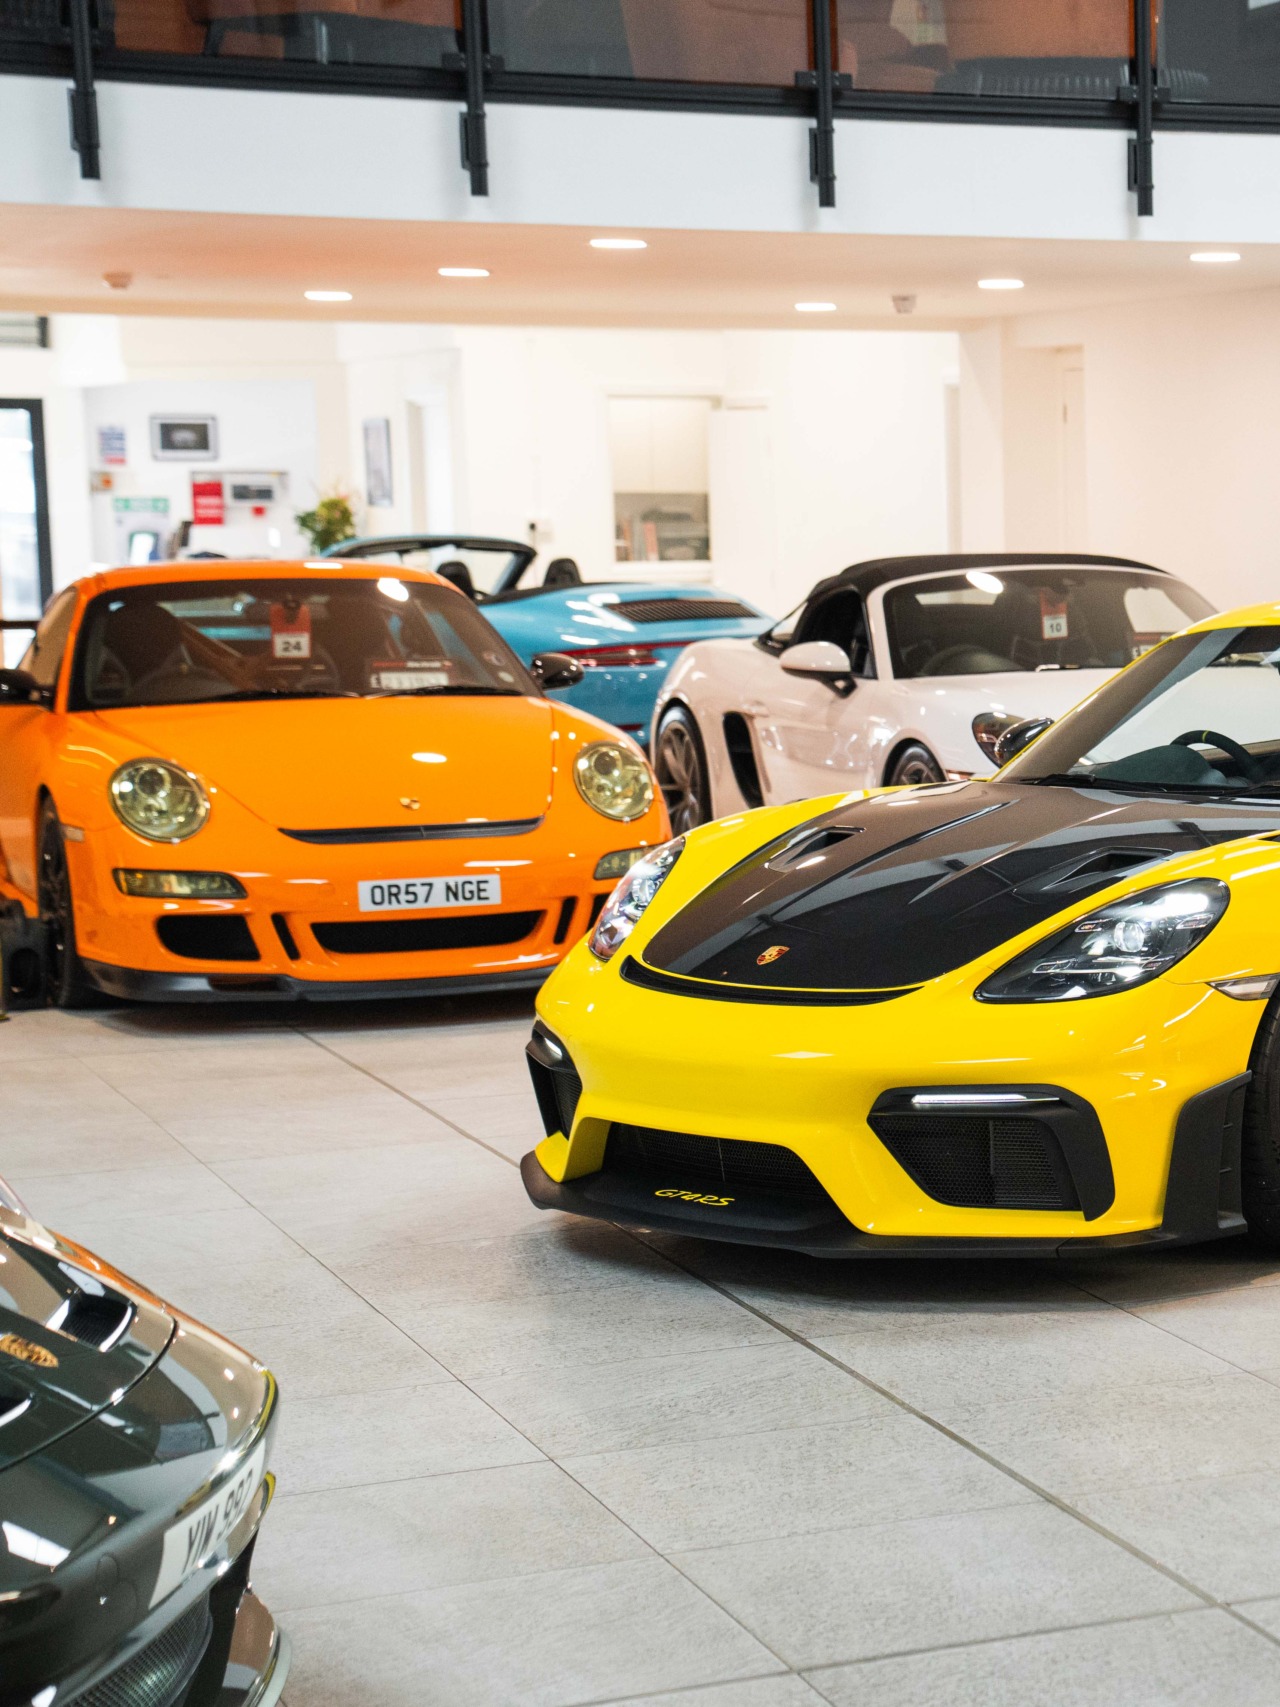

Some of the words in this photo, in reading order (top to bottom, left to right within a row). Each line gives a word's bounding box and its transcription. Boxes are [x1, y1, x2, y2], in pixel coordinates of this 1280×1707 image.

[1049, 623, 1062, 634] 10
[282, 641, 302, 653] 24
[370, 882, 434, 906] OR57
[445, 880, 490, 903] NGE
[654, 1189, 735, 1206] GT4RS
